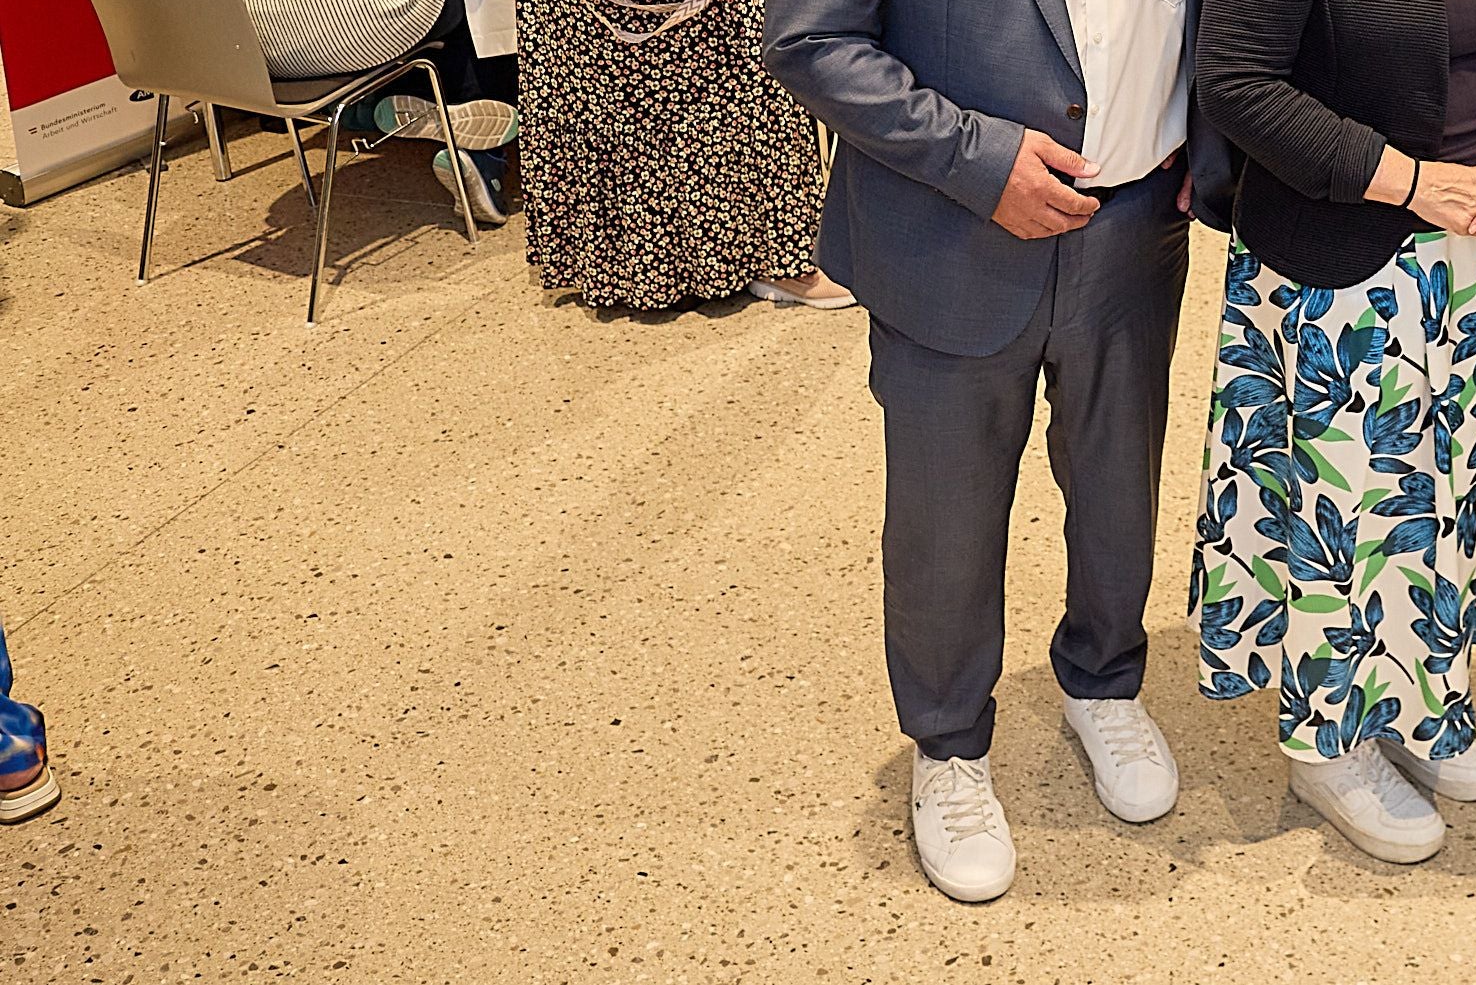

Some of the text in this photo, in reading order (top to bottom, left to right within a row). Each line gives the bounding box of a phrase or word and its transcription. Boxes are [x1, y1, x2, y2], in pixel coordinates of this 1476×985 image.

[40, 102, 107, 131] Bundesministerium
[42, 106, 118, 140] Arbeit und Wirtschaft
